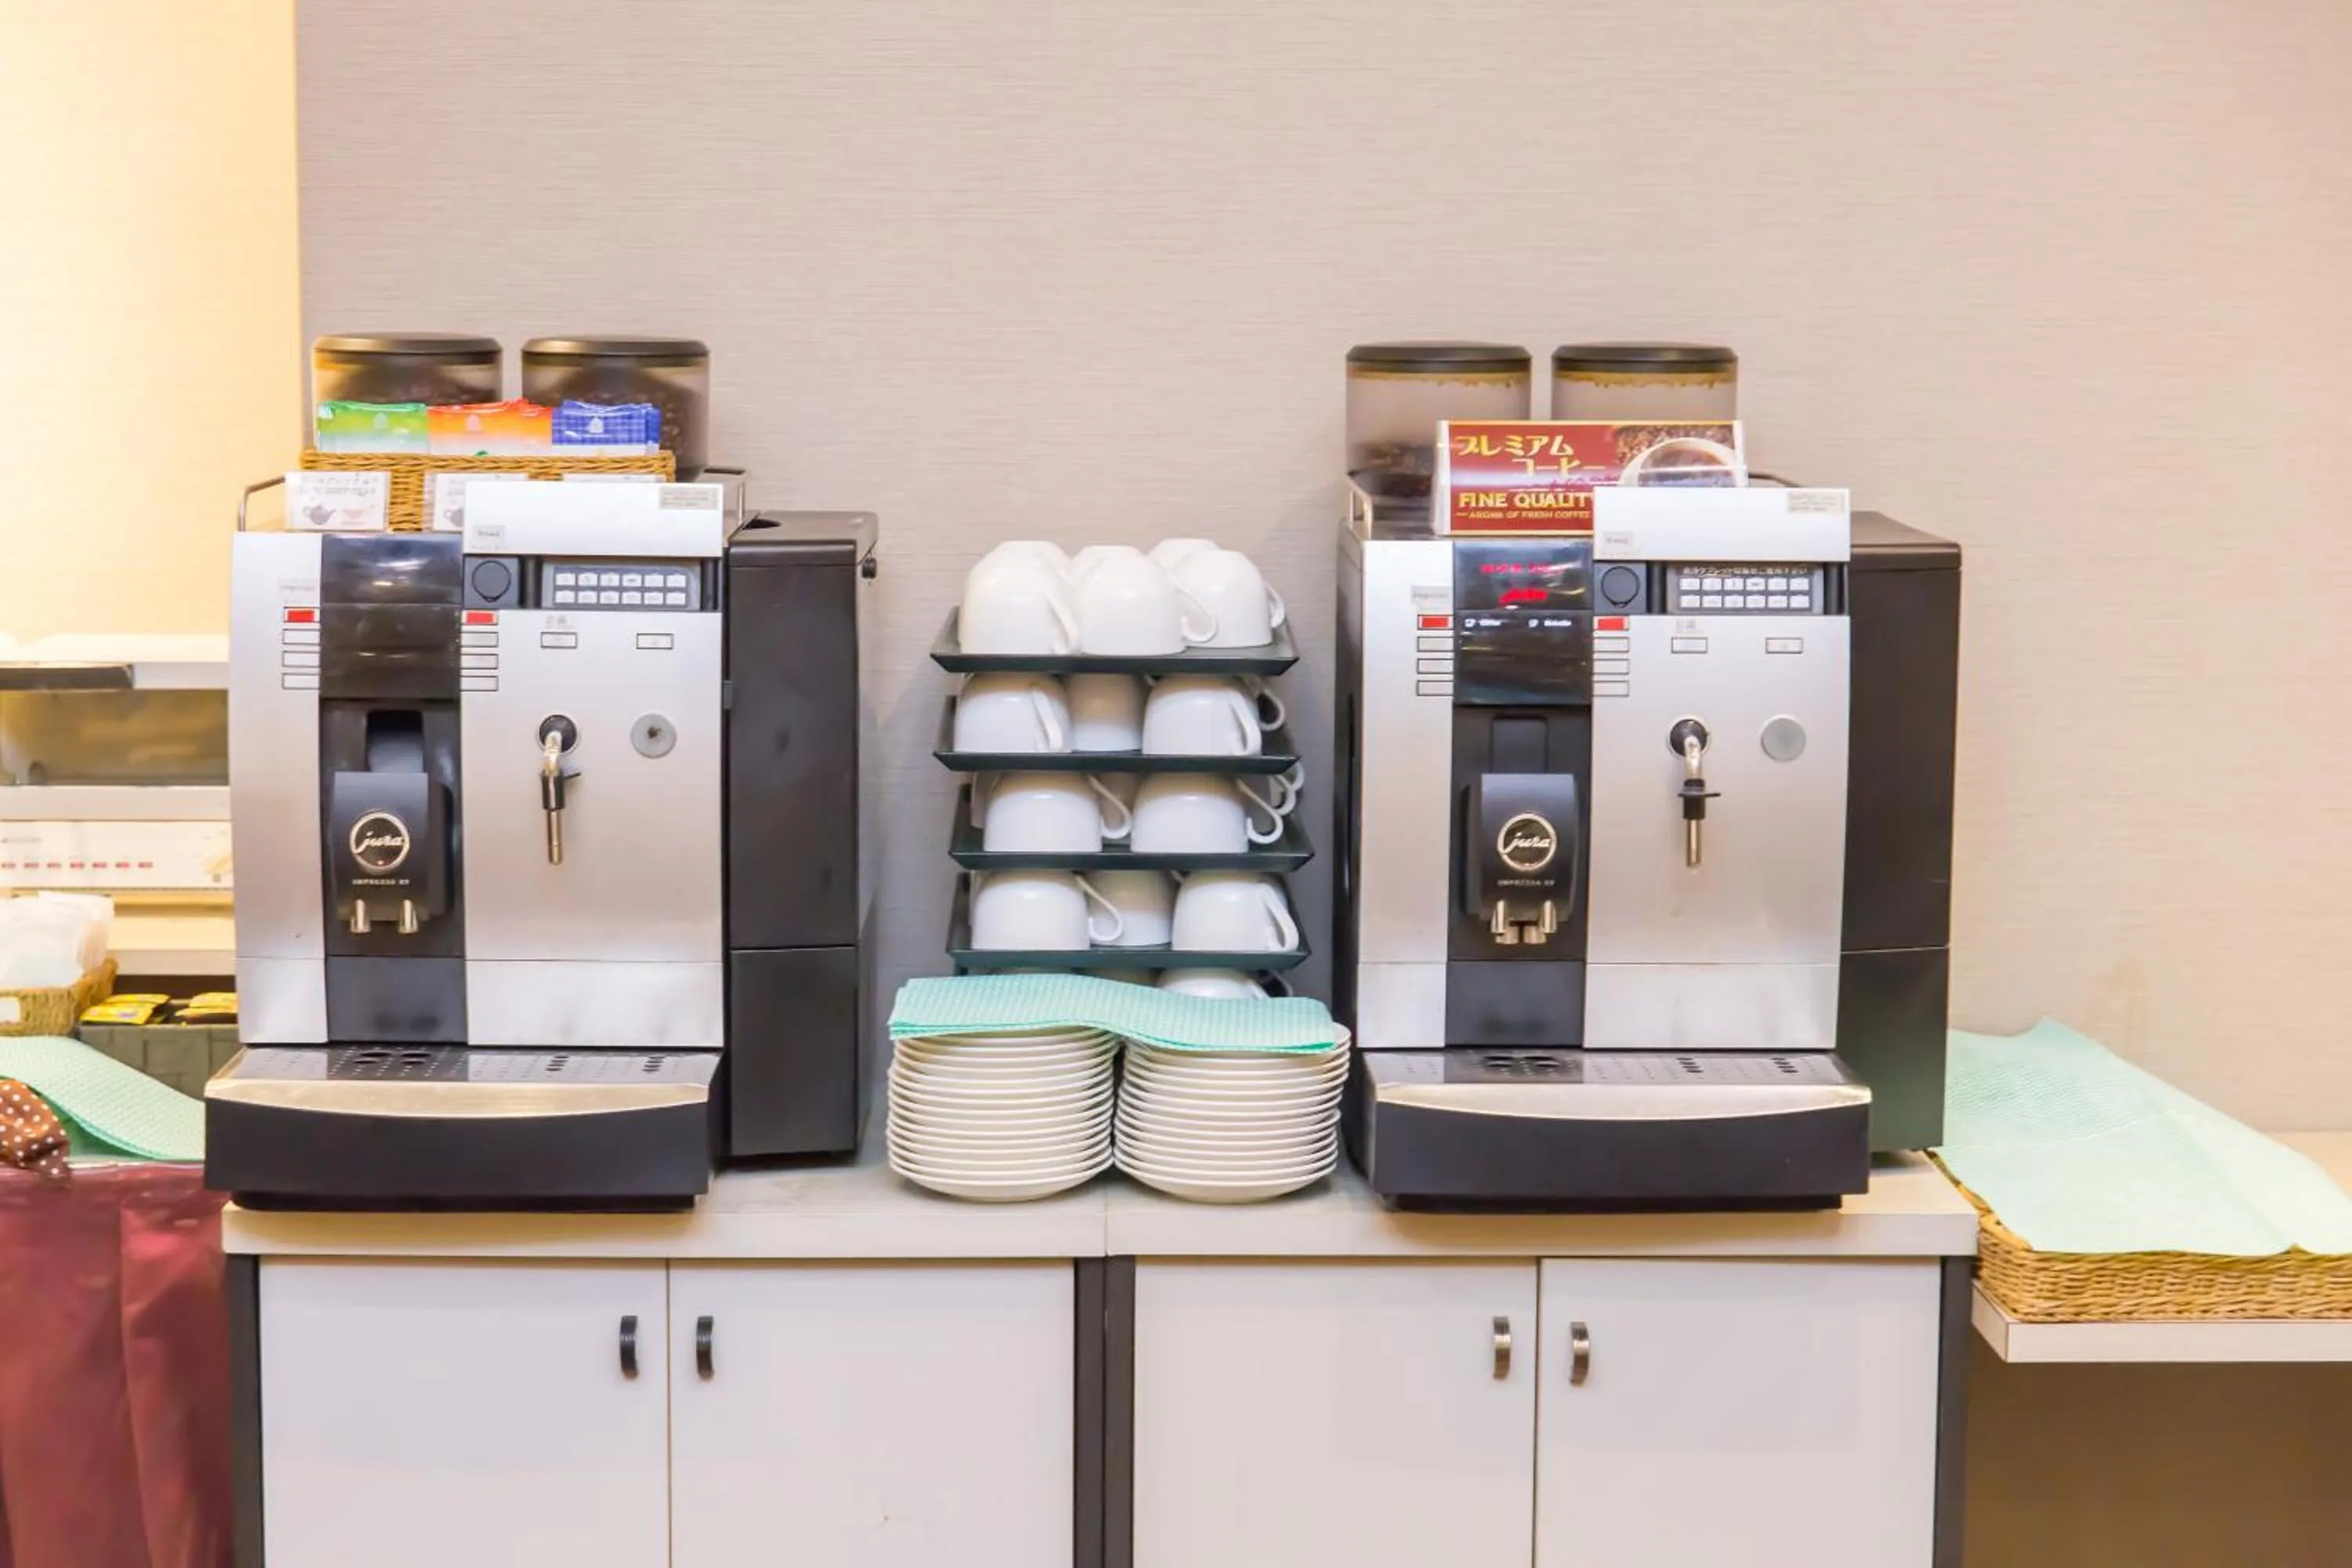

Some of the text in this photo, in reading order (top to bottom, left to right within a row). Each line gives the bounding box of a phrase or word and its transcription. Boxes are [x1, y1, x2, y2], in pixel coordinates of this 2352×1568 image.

[1454, 435, 1574, 456] プレミアム
[1459, 492, 1594, 509] FINE QUALIT
[1505, 511, 1519, 520] OF
[353, 831, 404, 854] jura
[1502, 831, 1552, 854] jura
